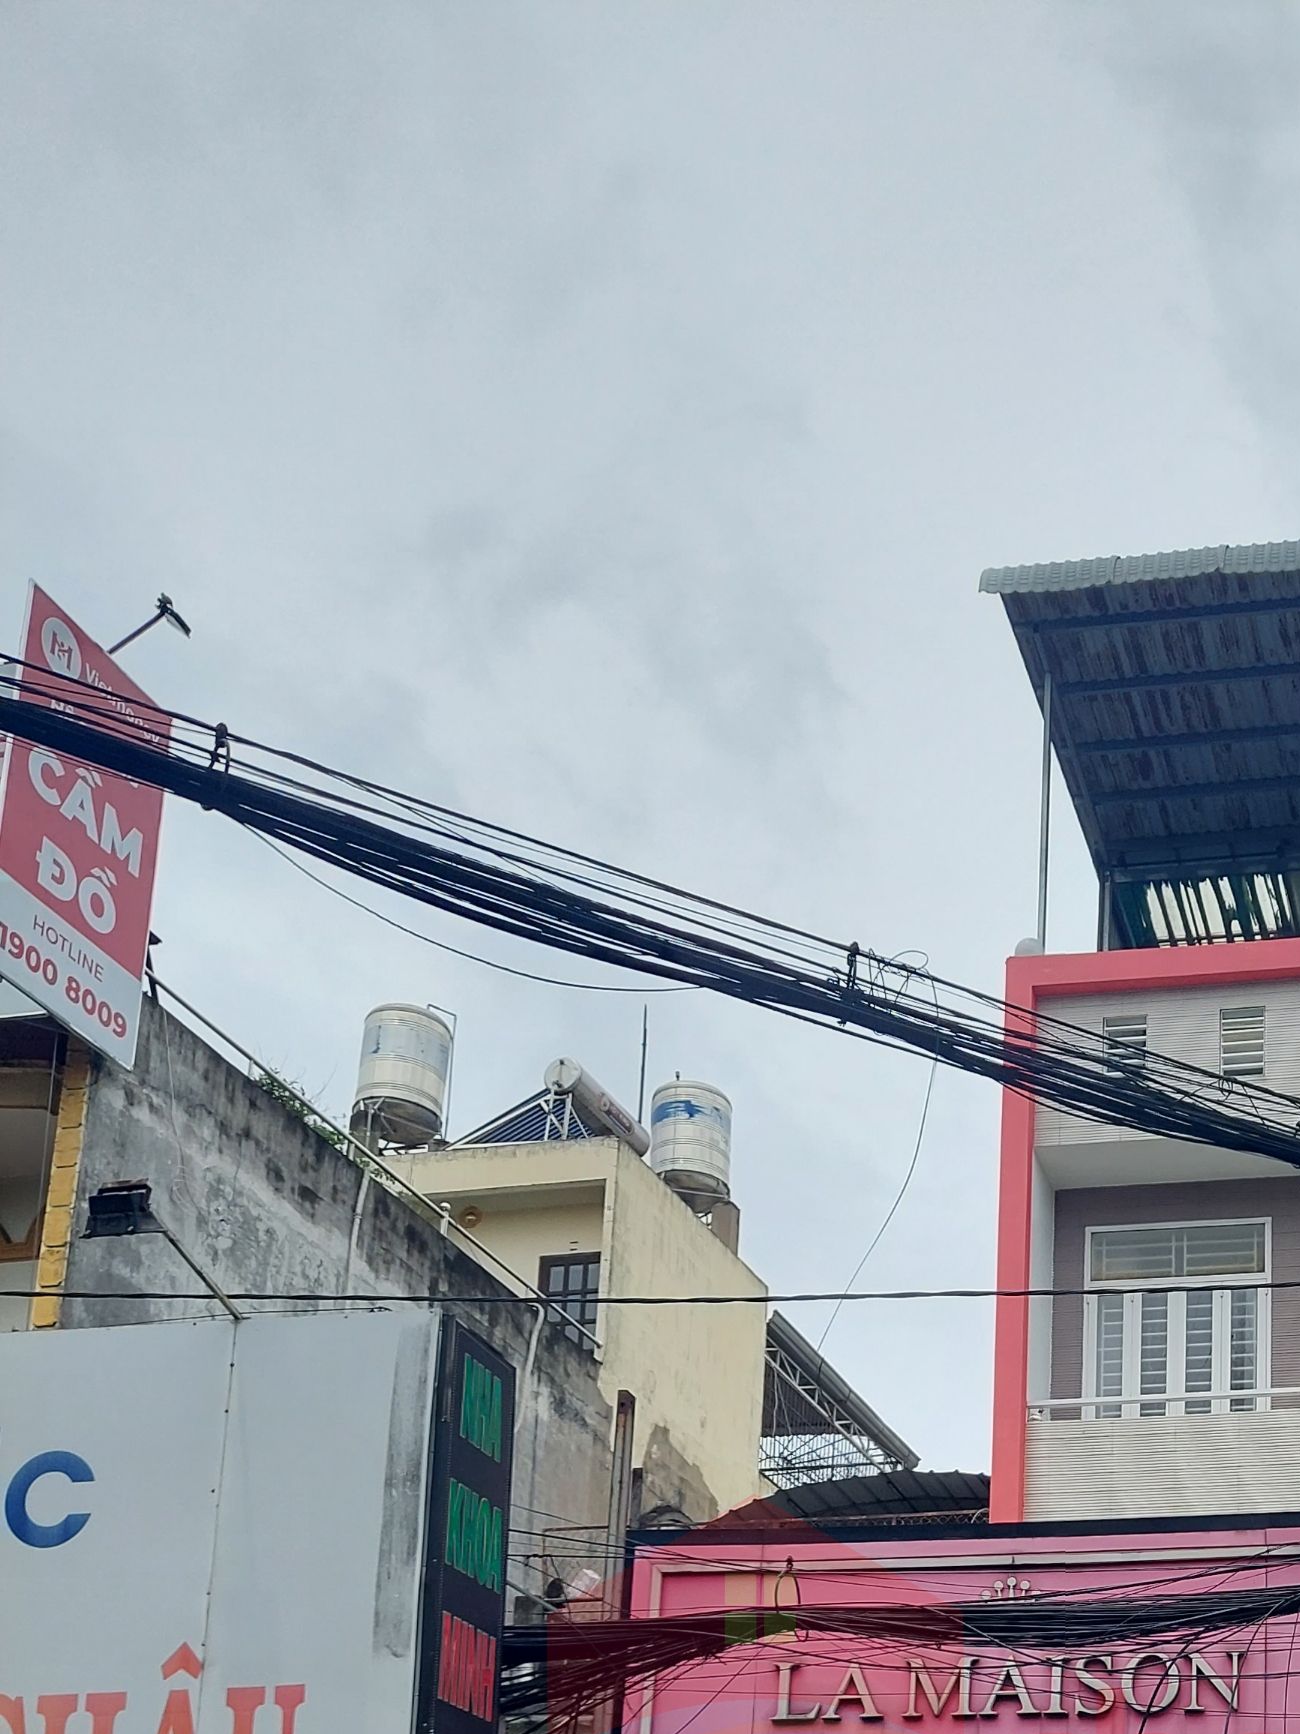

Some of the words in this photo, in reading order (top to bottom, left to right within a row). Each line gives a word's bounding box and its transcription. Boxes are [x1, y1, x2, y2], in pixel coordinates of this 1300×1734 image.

[28, 746, 143, 878] CẦM
[36, 835, 117, 934] ĐỒ
[34, 914, 104, 983] HOTLINE
[65, 976, 128, 1039] 8009
[460, 1353, 502, 1463] NHA
[445, 1477, 502, 1593] KHOA
[438, 1610, 497, 1722] MINH
[770, 1660, 884, 1726] LA
[901, 1650, 1244, 1720] MAISON
